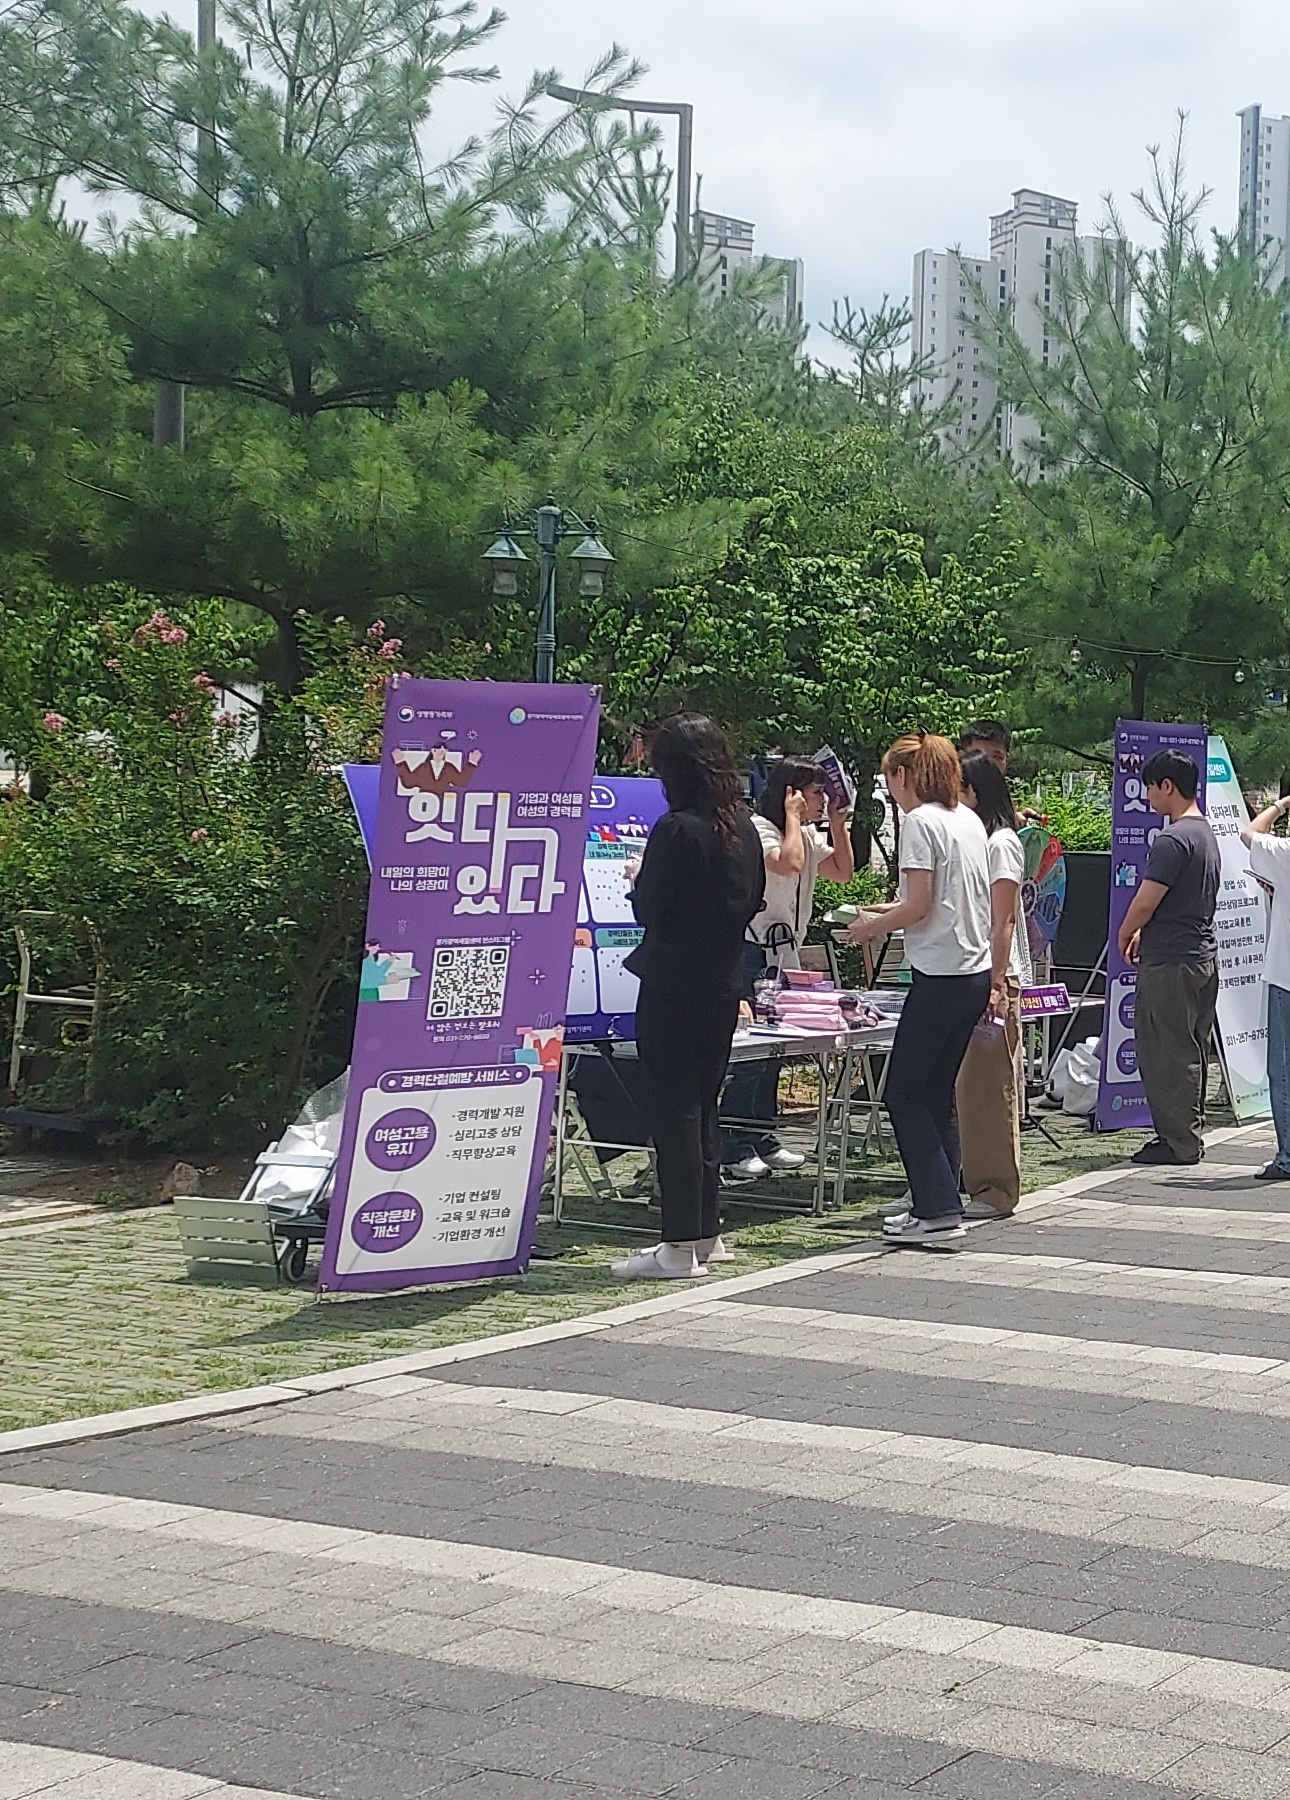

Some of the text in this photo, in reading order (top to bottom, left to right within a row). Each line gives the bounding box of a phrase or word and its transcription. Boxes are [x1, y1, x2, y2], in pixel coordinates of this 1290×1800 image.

[518, 793, 549, 805] 기업과
[517, 807, 548, 818] 여성의
[380, 865, 450, 879] 내일의 희망이
[390, 879, 449, 891] 나의 성장이
[475, 1069, 511, 1082] 서비스
[457, 1105, 525, 1121] 경력개발 지원
[374, 1126, 430, 1142] 여성고용
[500, 1125, 523, 1138] 상담
[386, 1142, 414, 1157] 유지
[451, 1145, 517, 1160] 직무향상교육
[443, 1188, 501, 1204] 기업 컨설팅
[360, 1209, 417, 1224] 직장문화
[439, 1212, 463, 1223] 교육
[466, 1210, 476, 1222] 및
[372, 1225, 400, 1239] 개선
[437, 1225, 506, 1243] 기업환경 개선
